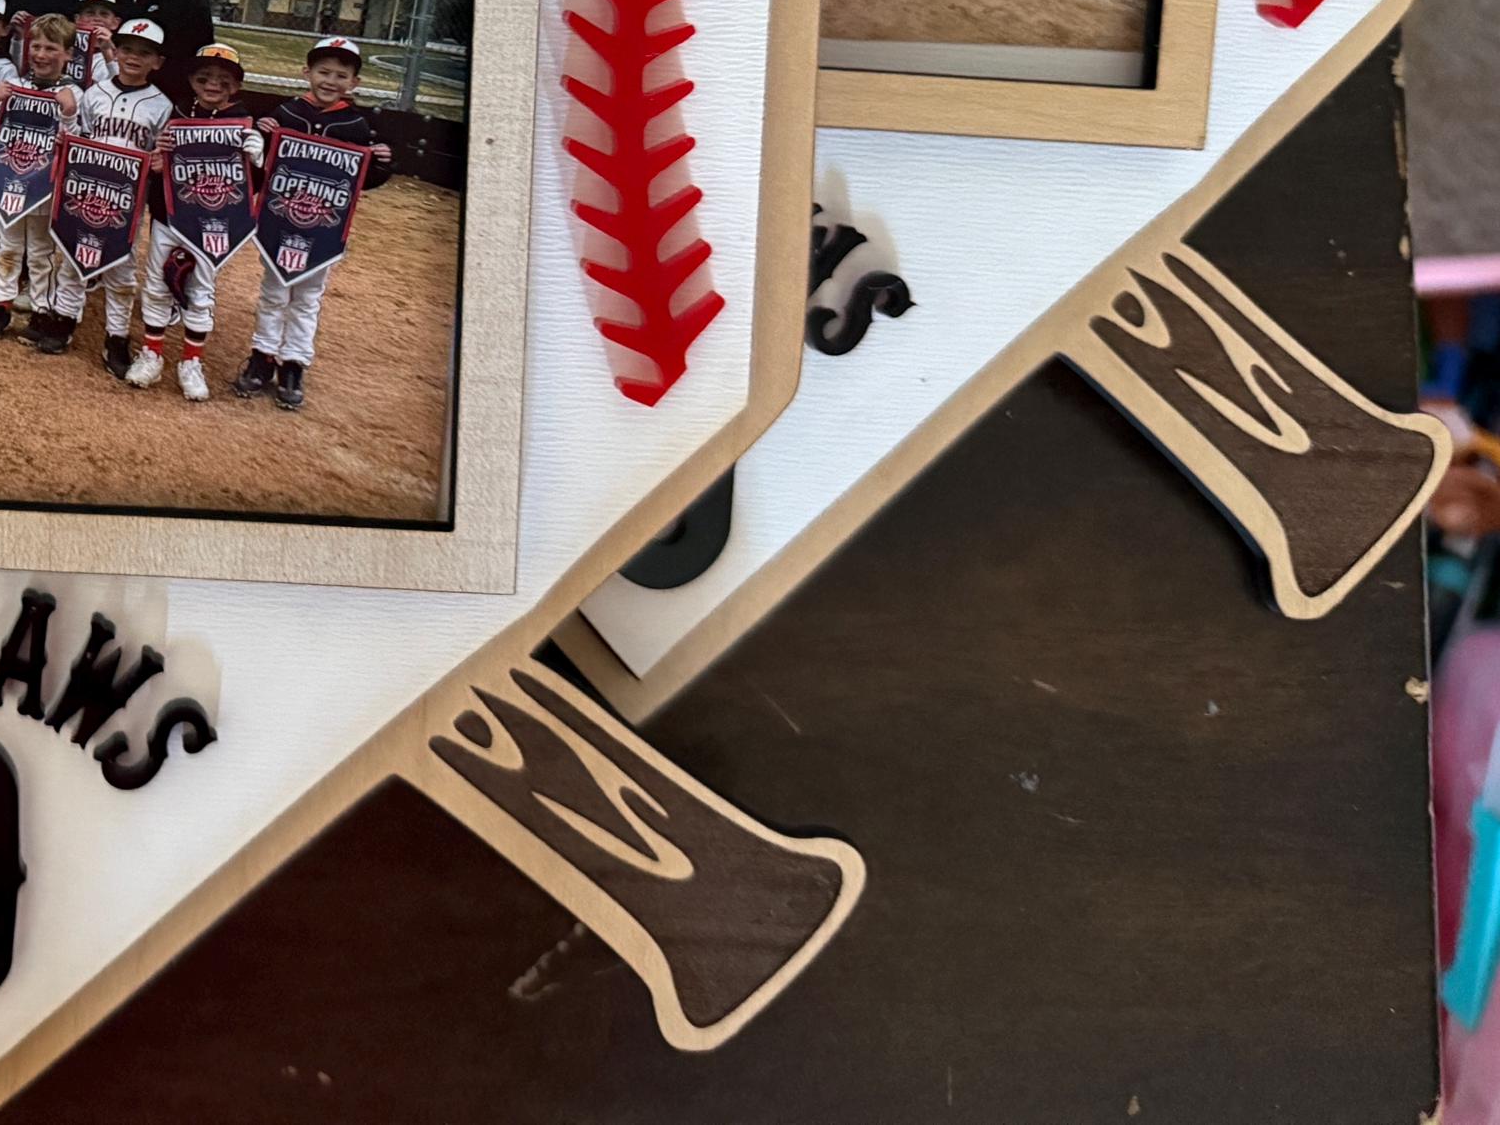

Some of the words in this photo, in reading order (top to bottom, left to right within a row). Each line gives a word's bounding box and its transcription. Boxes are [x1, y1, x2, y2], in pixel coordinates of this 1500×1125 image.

[0, 127, 56, 151] OPENING
[91, 115, 150, 150] HAWKS
[68, 146, 140, 182] CHAMPIONS
[174, 163, 244, 182] OPENING
[277, 139, 361, 177] CHAMPIONS
[66, 179, 132, 210] OPENING
[272, 175, 349, 208] OPENING
